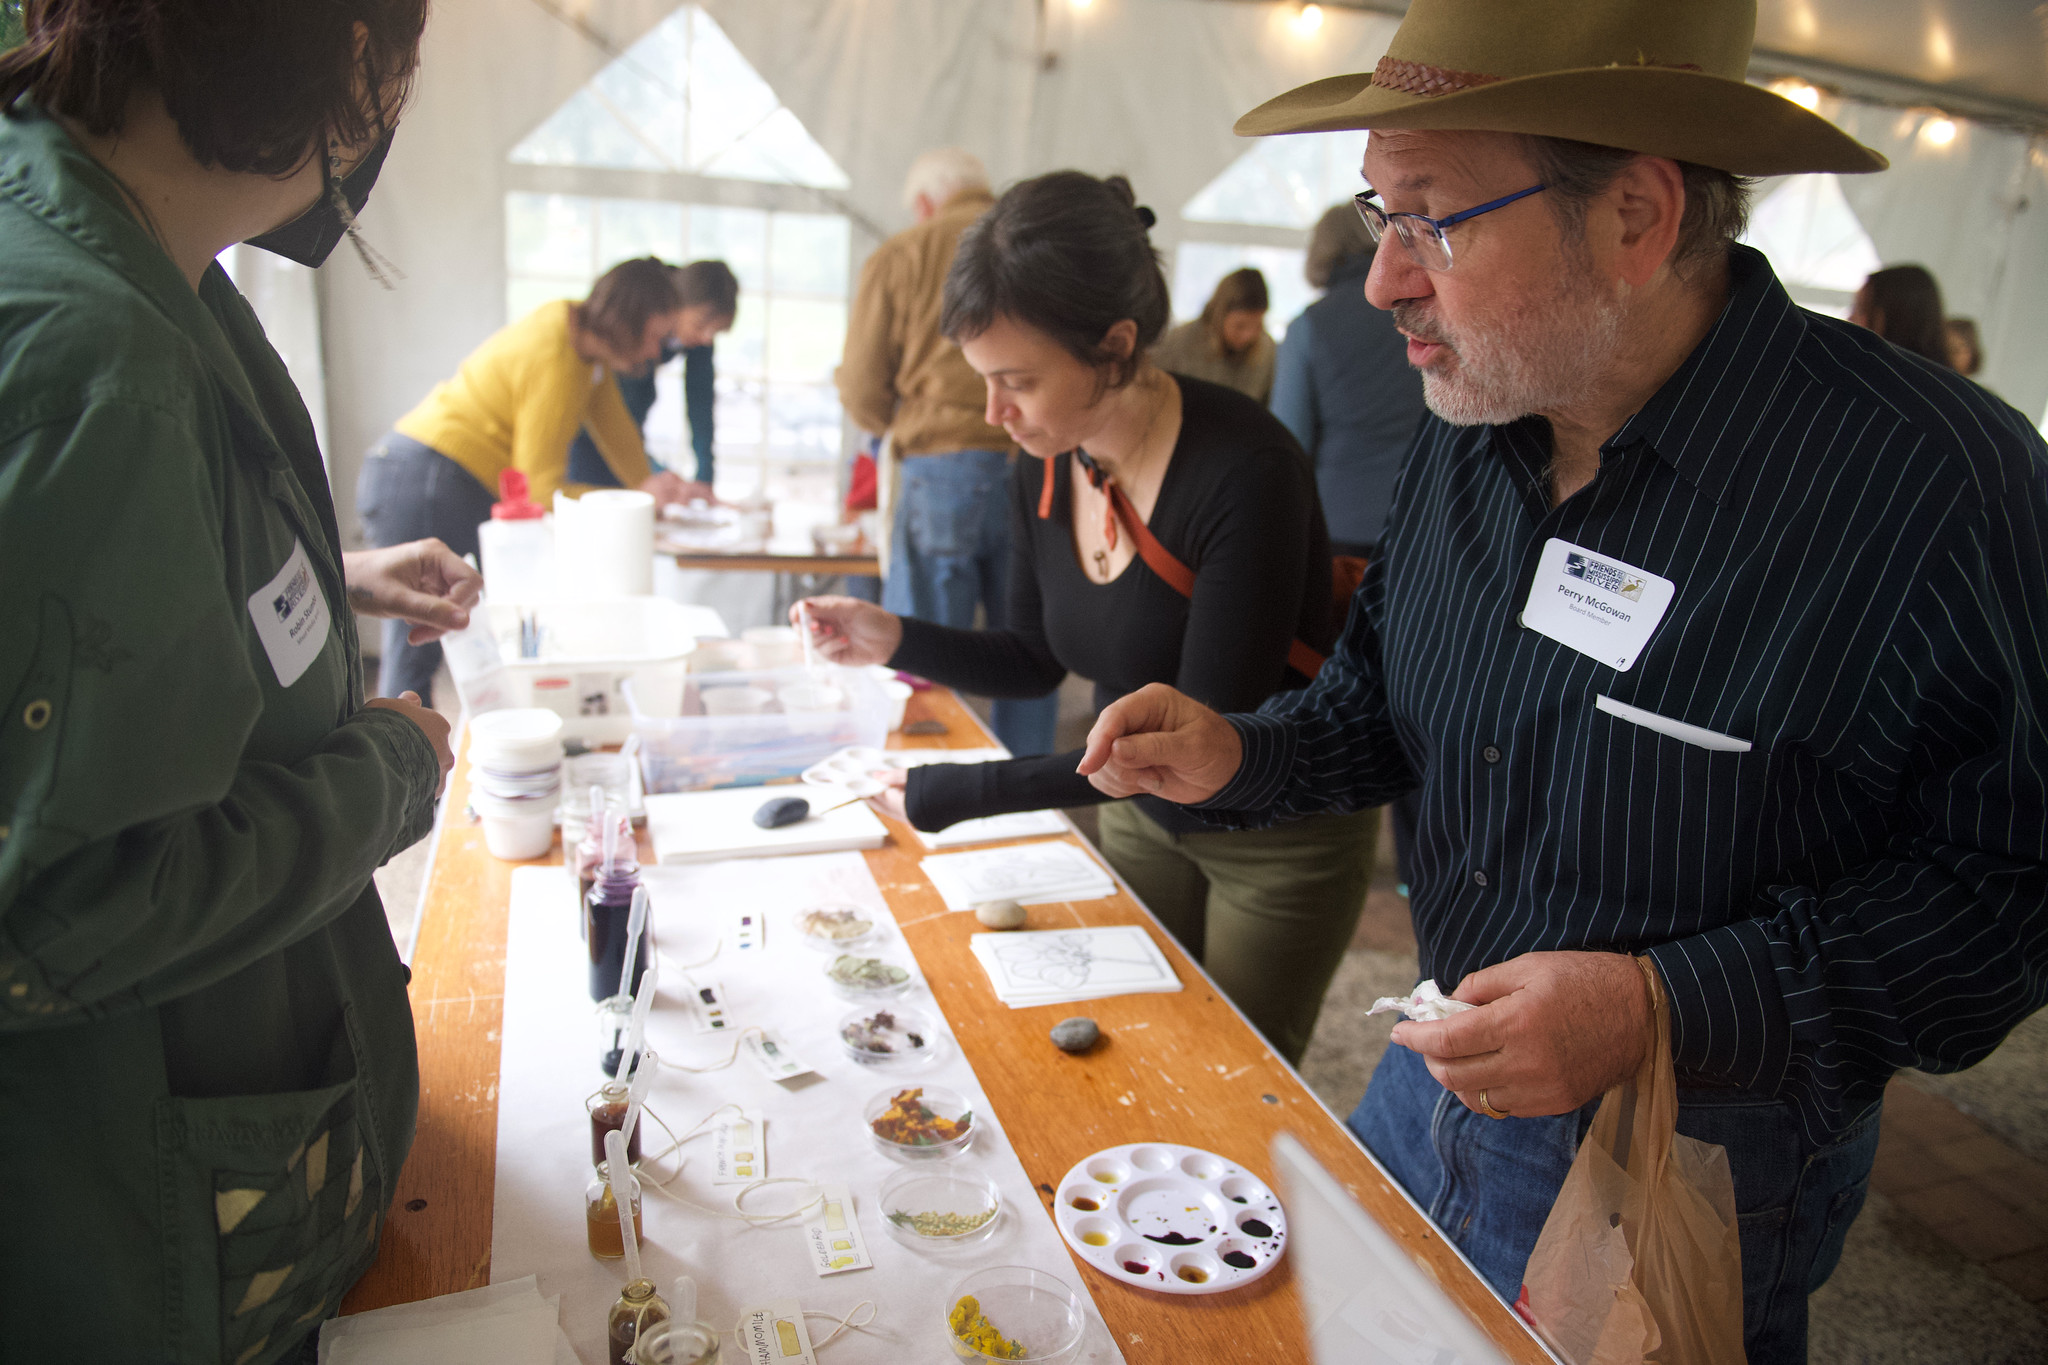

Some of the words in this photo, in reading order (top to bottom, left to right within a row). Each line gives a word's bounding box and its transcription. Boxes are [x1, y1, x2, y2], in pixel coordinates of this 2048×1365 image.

[1589, 569, 1621, 586] MISSISSIPPI
[1590, 561, 1618, 578] FRIENDS
[1586, 574, 1620, 592] RIVER
[1558, 584, 1584, 603] Perry
[1585, 595, 1631, 623] McGowan
[1568, 603, 1587, 616] Board
[1587, 610, 1612, 627] Member
[290, 617, 305, 639] Robin
[752, 1312, 771, 1365] HAMMOMILE
